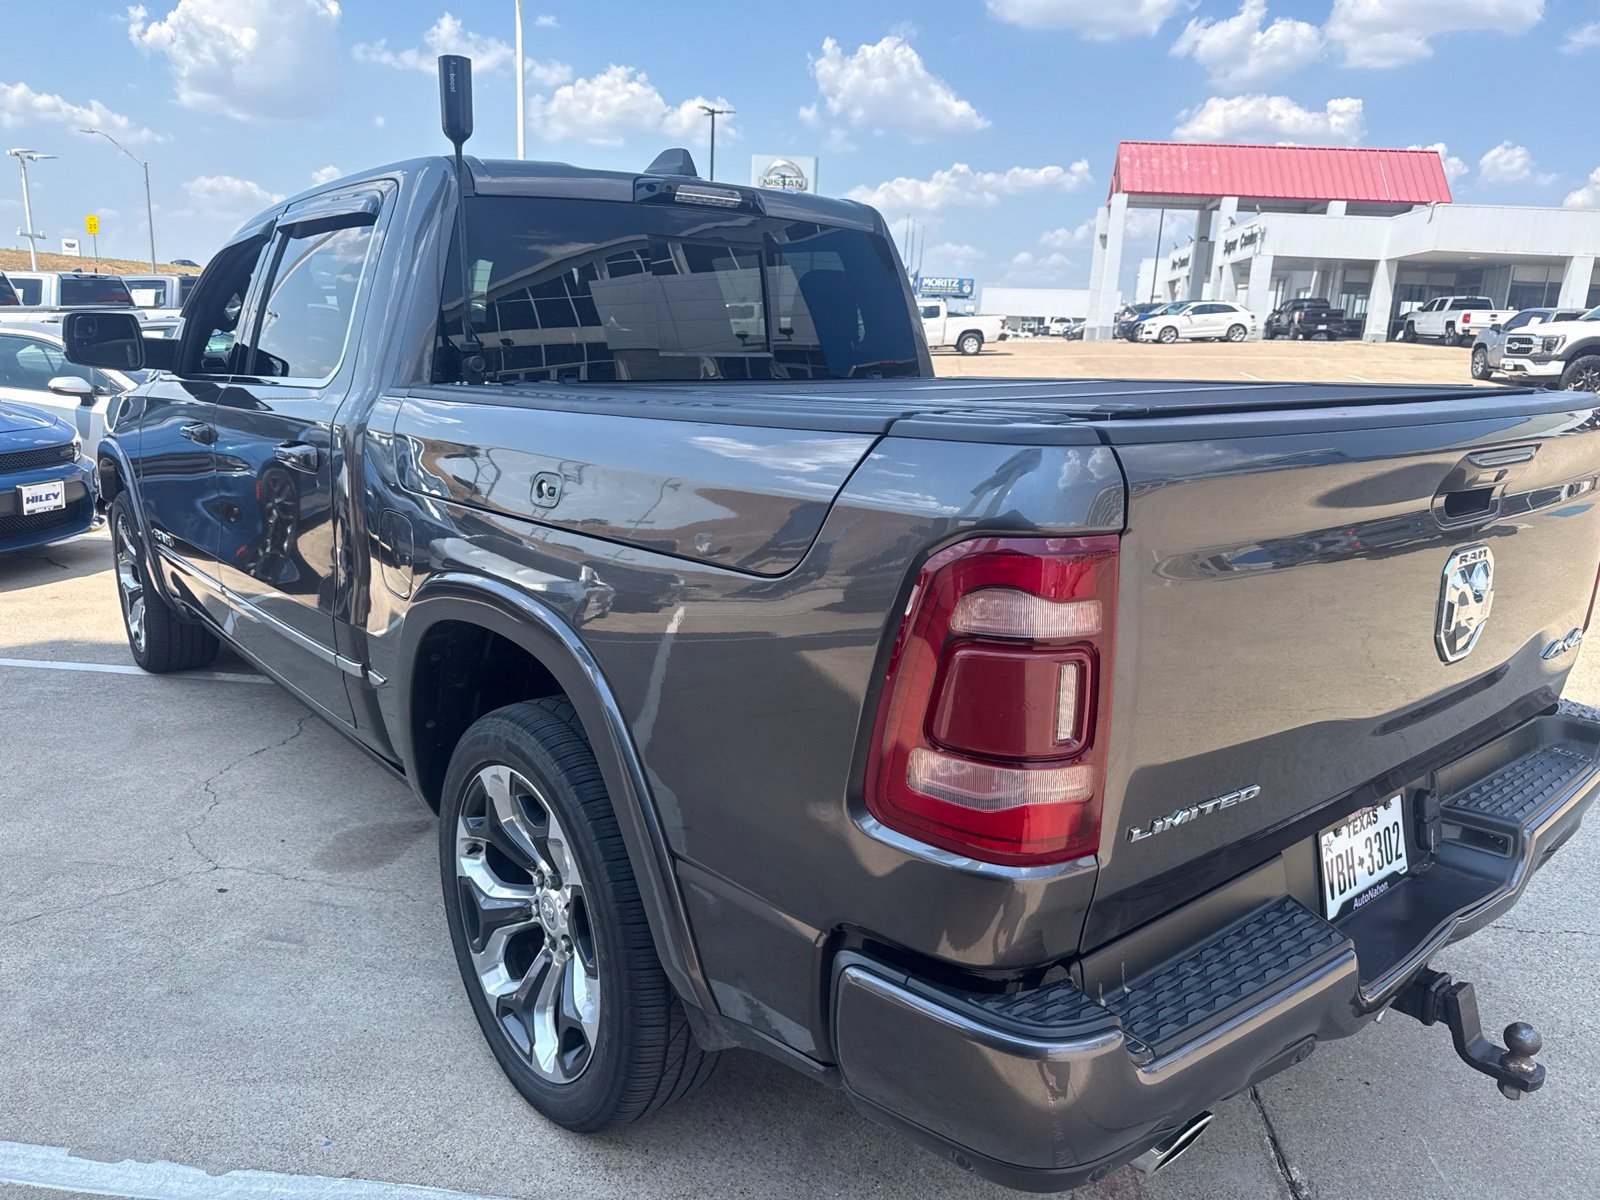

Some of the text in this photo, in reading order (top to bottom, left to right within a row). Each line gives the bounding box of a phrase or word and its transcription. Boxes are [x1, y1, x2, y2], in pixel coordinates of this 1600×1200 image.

[763, 179, 803, 188] NISSAN
[922, 278, 959, 287] MORITZ
[26, 492, 60, 504] HILEY
[1459, 549, 1487, 565] RAM
[1129, 784, 1261, 843] LIMITED
[1345, 808, 1379, 838] TEXAS
[1353, 881, 1388, 910] AutoNation
